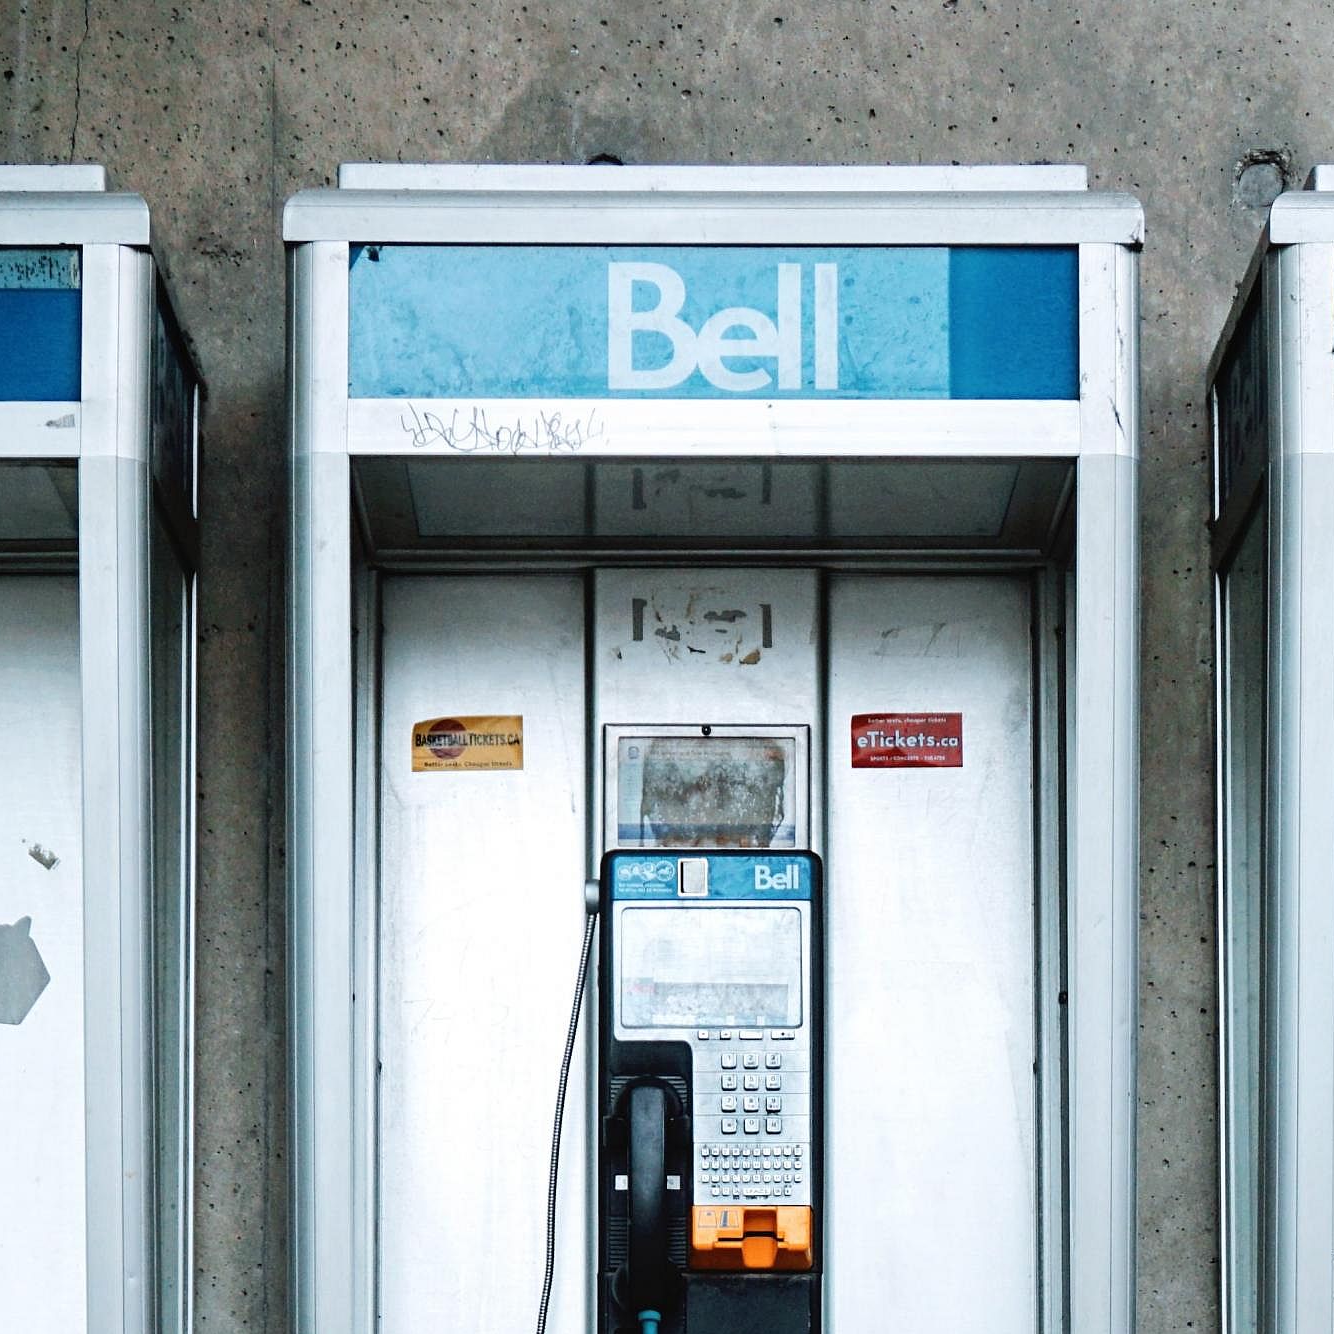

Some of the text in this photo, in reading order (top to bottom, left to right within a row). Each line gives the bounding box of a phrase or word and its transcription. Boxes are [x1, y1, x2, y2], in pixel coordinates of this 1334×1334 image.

[607, 261, 839, 391] Bell
[857, 729, 959, 748] eTickets.ca
[754, 864, 799, 890] Bell
